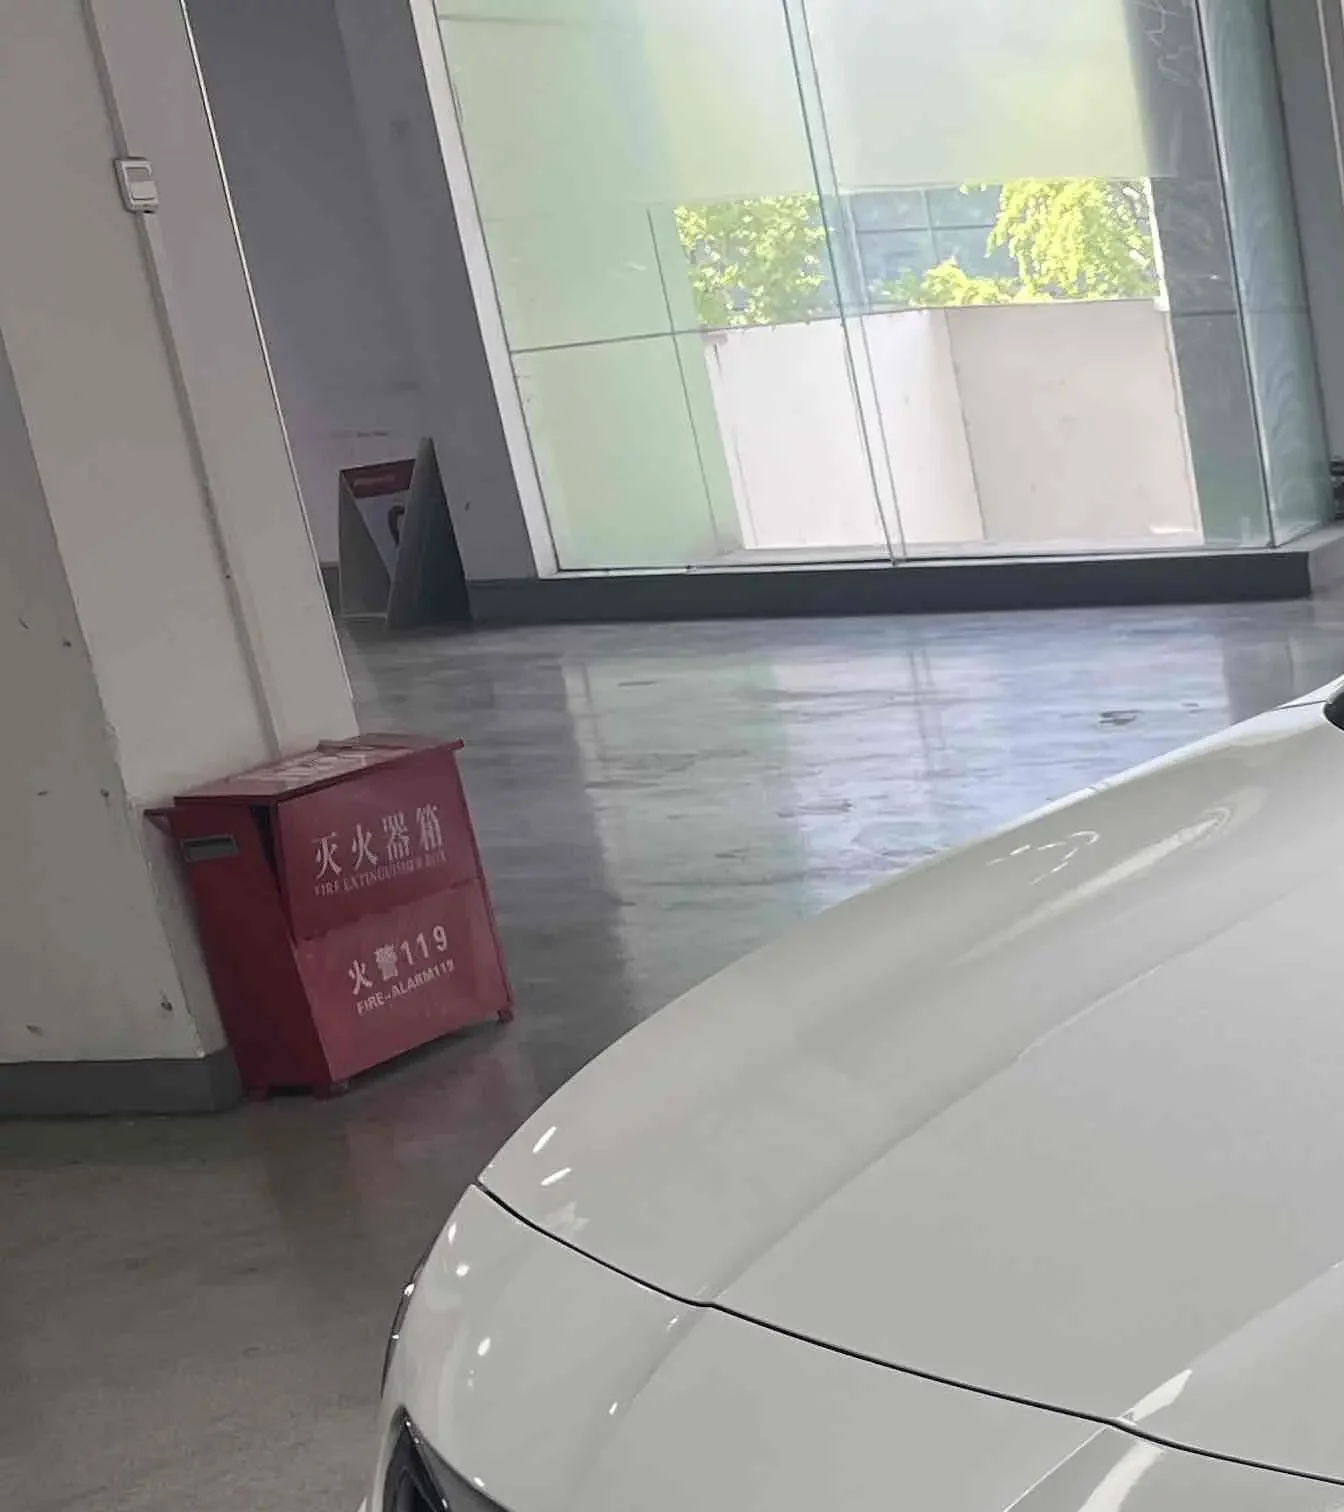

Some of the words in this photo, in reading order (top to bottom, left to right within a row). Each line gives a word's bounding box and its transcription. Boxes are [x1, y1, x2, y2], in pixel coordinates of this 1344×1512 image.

[311, 803, 442, 880] 灭火器箱
[348, 925, 448, 995] 火警119
